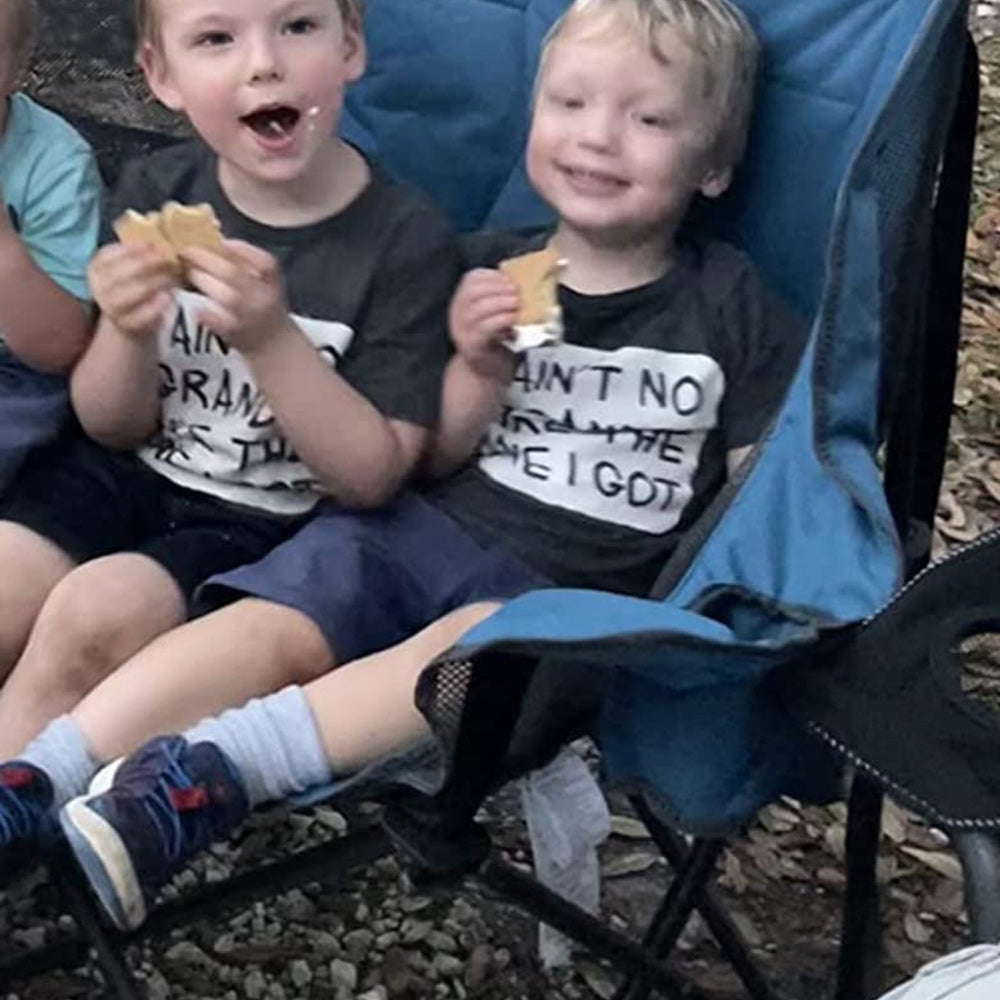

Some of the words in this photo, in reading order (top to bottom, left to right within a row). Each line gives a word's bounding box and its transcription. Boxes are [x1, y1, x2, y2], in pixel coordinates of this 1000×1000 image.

[638, 367, 703, 417] NO
[566, 452, 578, 487] I
[592, 460, 682, 512] GOT
